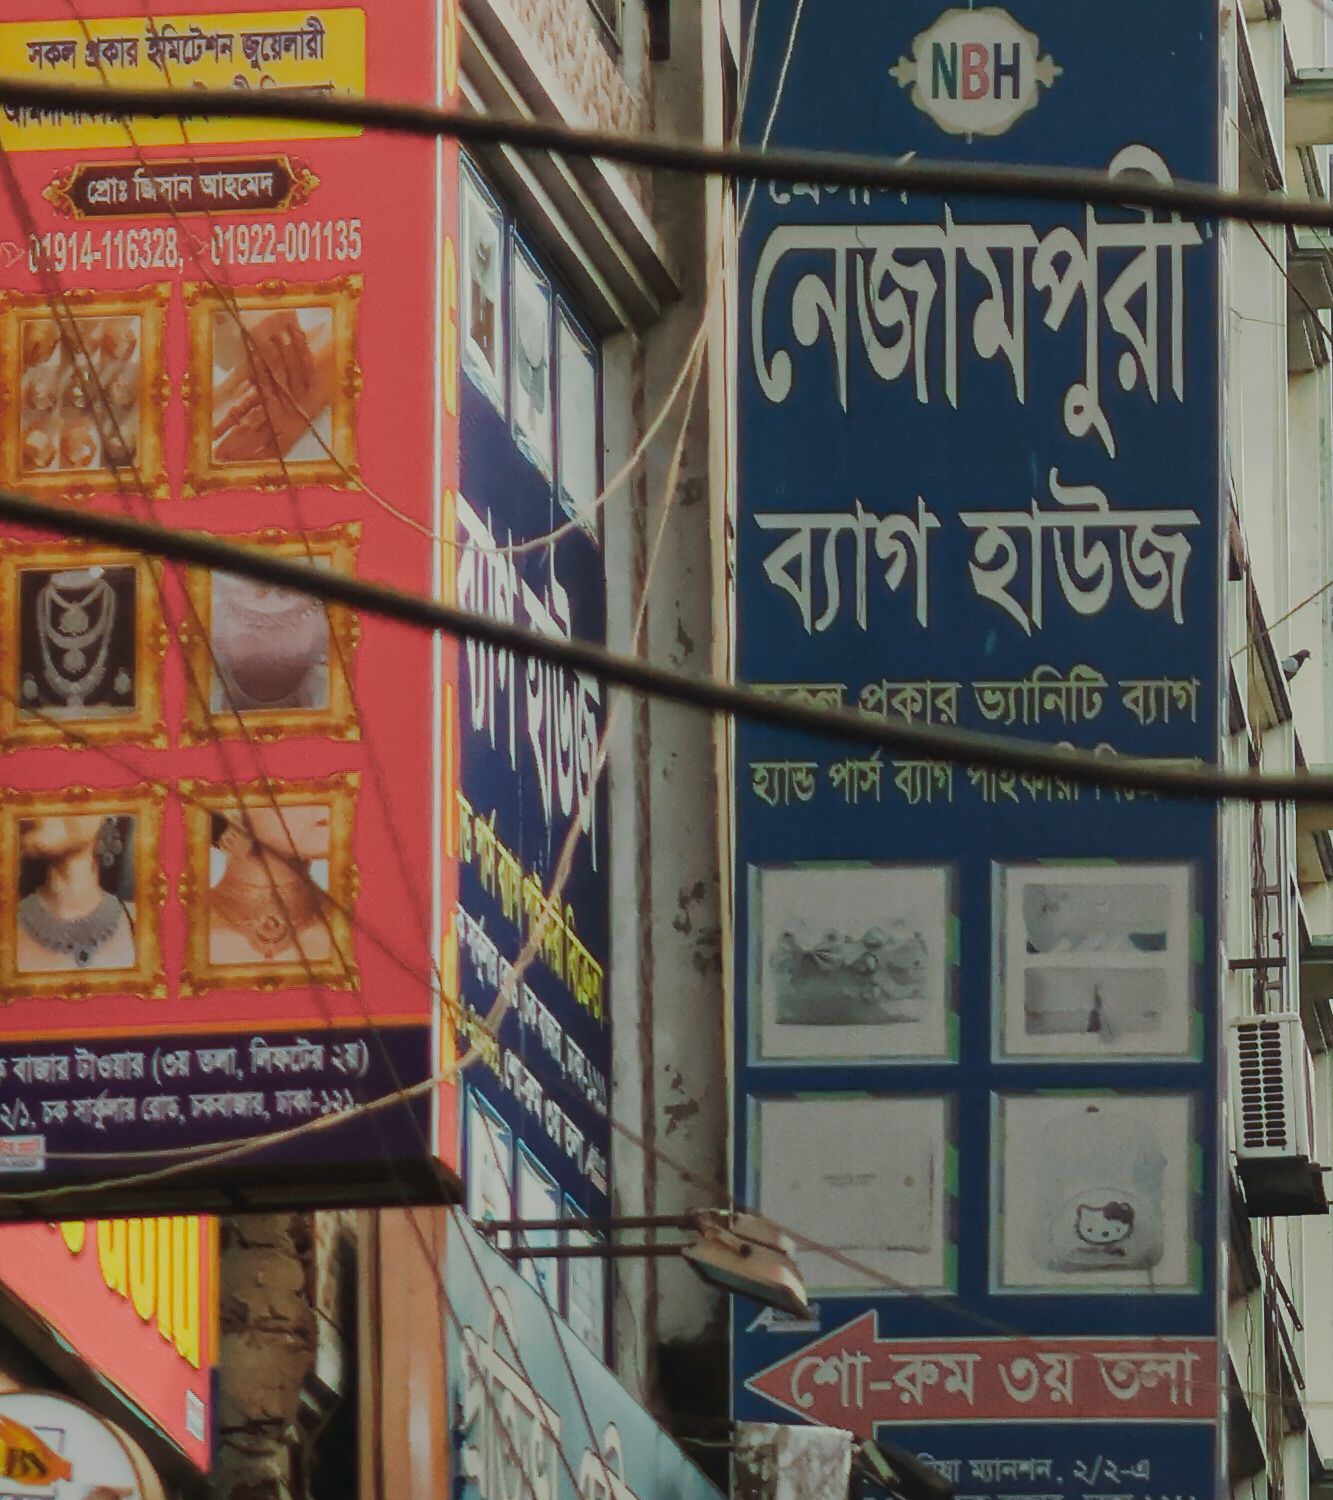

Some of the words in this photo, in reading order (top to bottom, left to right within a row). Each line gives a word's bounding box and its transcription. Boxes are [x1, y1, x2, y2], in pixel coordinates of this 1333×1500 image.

[931, 42, 1021, 99] NBH
[754, 496, 941, 636] ব্যাগ
[958, 468, 1200, 638] হাউজ
[971, 664, 1109, 725] ভ্যানিটি
[1117, 677, 1201, 724] ব্যাগ
[791, 1349, 981, 1409] শো-রুম
[1000, 1351, 1081, 1405] ৩য়
[1096, 1348, 1201, 1407] তলা
